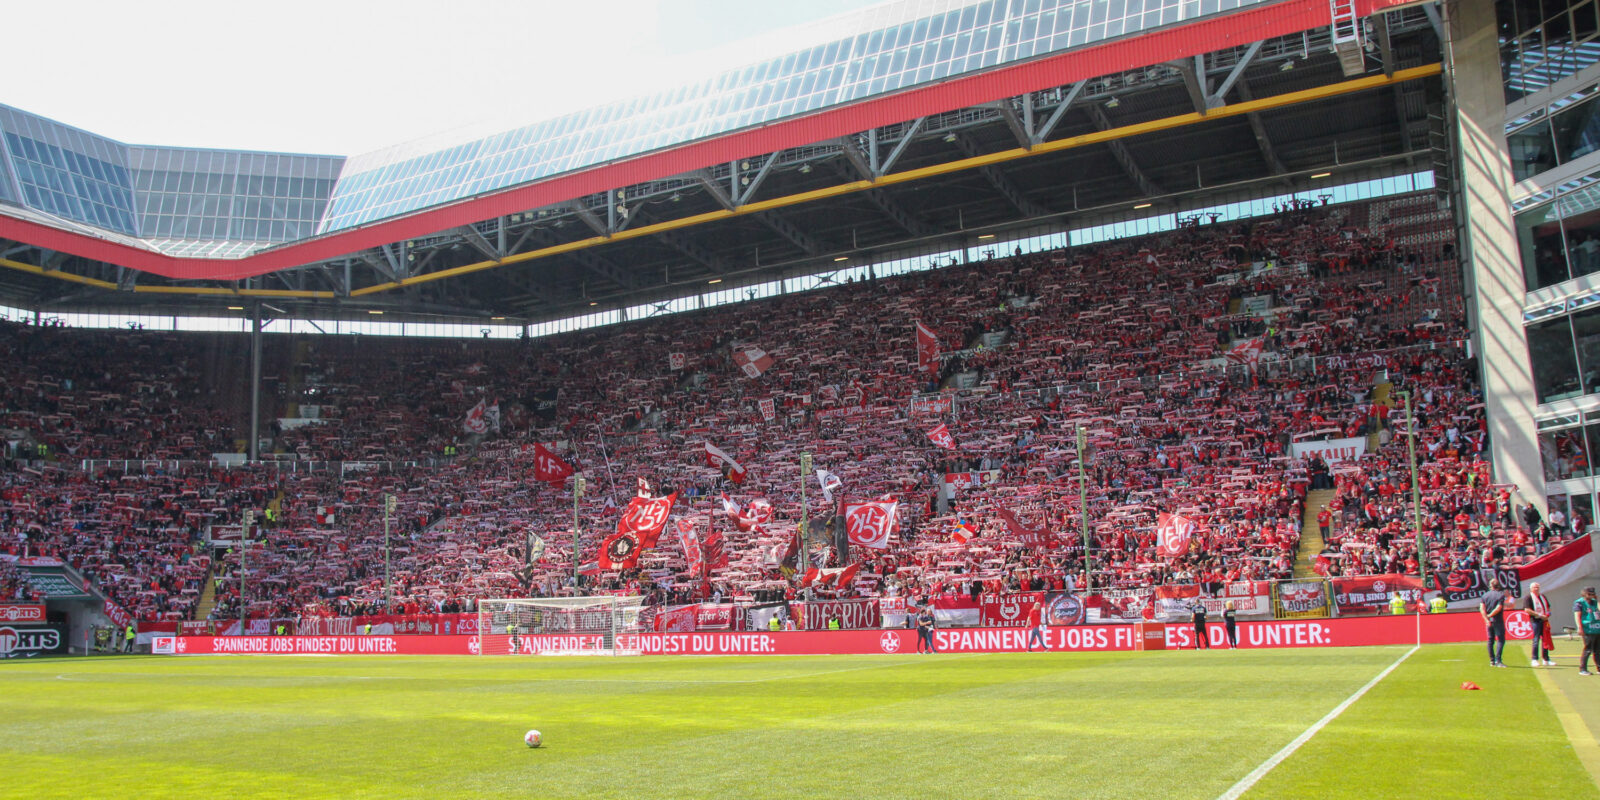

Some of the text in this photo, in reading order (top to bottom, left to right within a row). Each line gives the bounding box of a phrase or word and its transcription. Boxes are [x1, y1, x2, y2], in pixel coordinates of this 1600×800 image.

[1348, 590, 1411, 603] WIR SIND BZE
[628, 634, 688, 652] FINDEST
[692, 634, 714, 652] DU
[719, 634, 775, 652] UNTER:
[1058, 628, 1108, 649] JOBS
[1248, 623, 1332, 646] UNTER:
[213, 637, 397, 652] SPANNENDE JOBS FINDEST DU UNTER:
